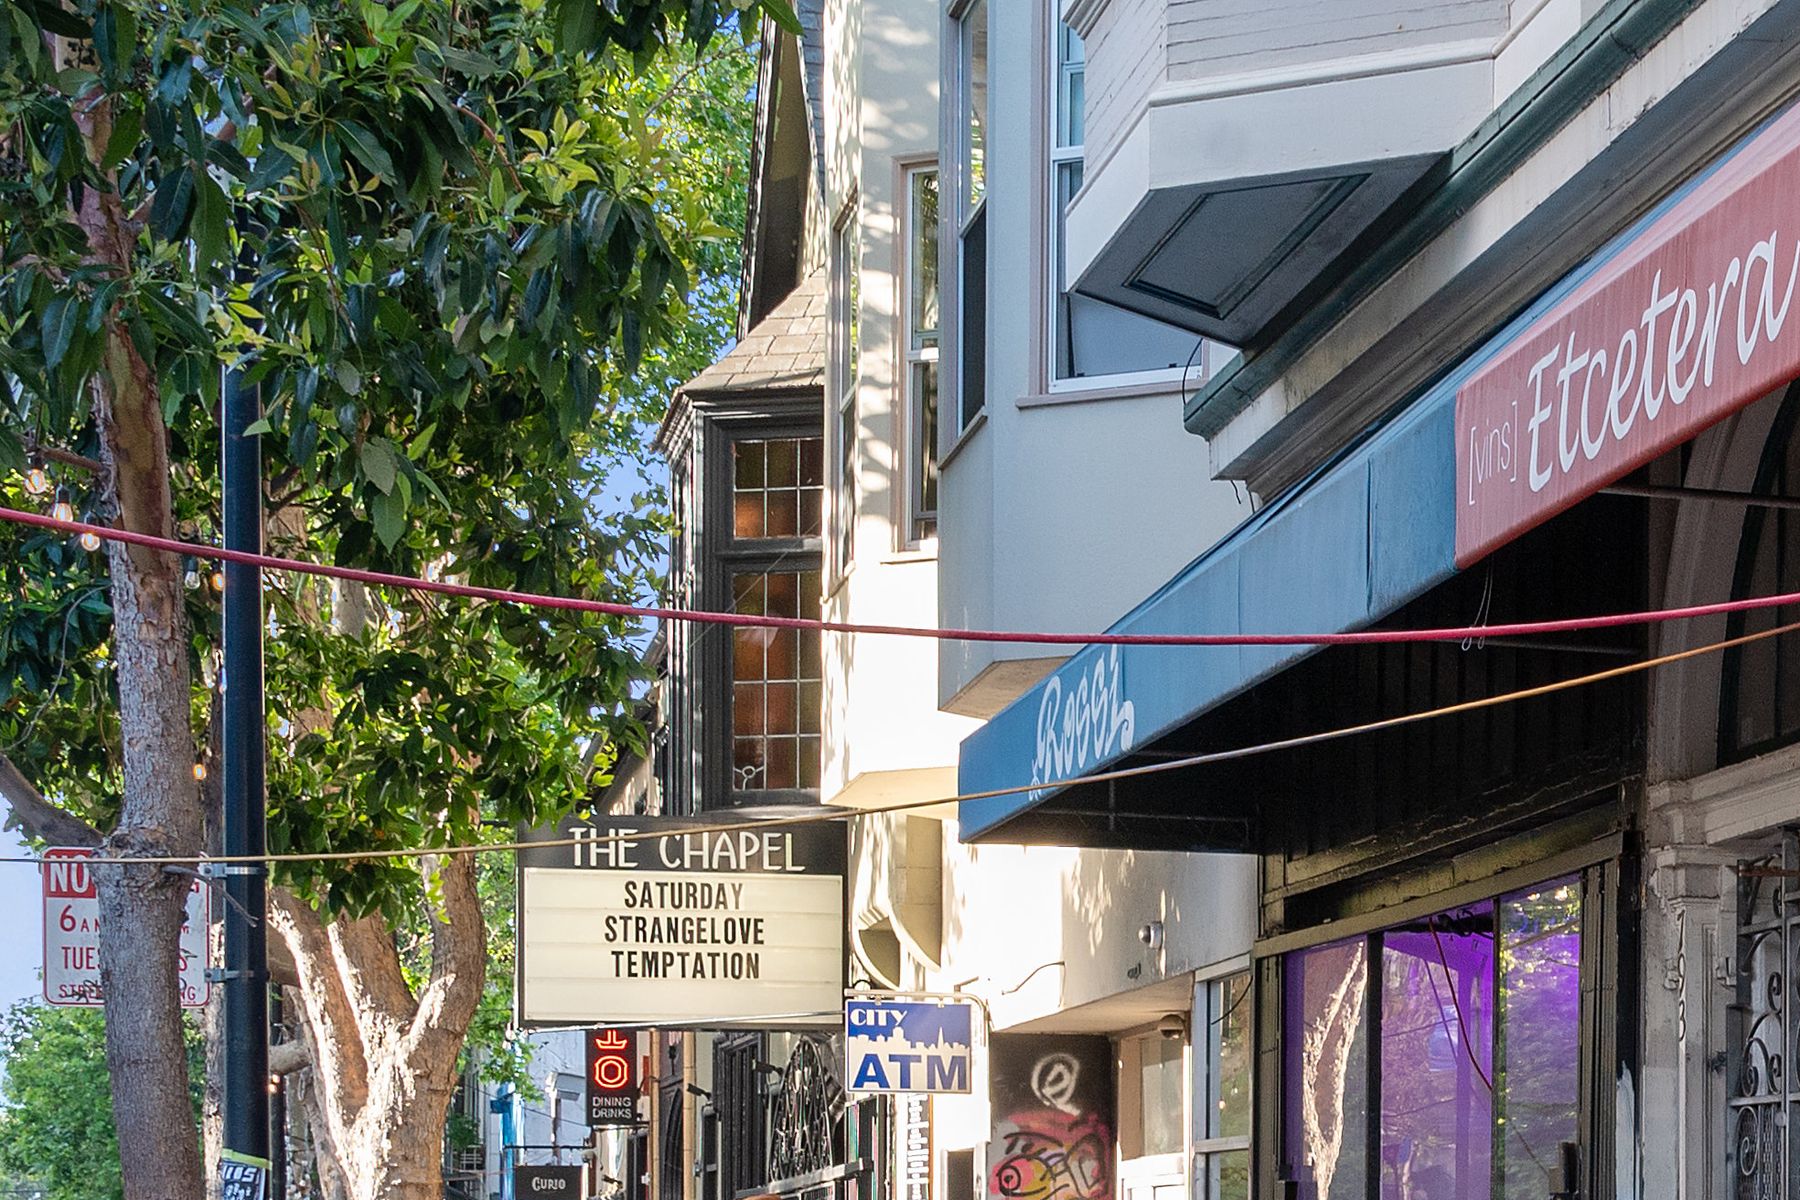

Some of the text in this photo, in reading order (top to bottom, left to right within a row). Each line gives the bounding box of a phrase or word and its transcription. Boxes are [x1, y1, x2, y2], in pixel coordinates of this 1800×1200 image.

[1468, 399, 1518, 506] [vins]
[569, 826, 806, 873] THE CHAPEL
[624, 880, 744, 911] SATURDAY
[604, 915, 765, 946] STRANGELOVE
[611, 950, 760, 980] TEMPTATION
[850, 1008, 908, 1027] CITY
[852, 1053, 967, 1091] ATM
[592, 1096, 632, 1108] DINING
[592, 1108, 632, 1119] DRINKS
